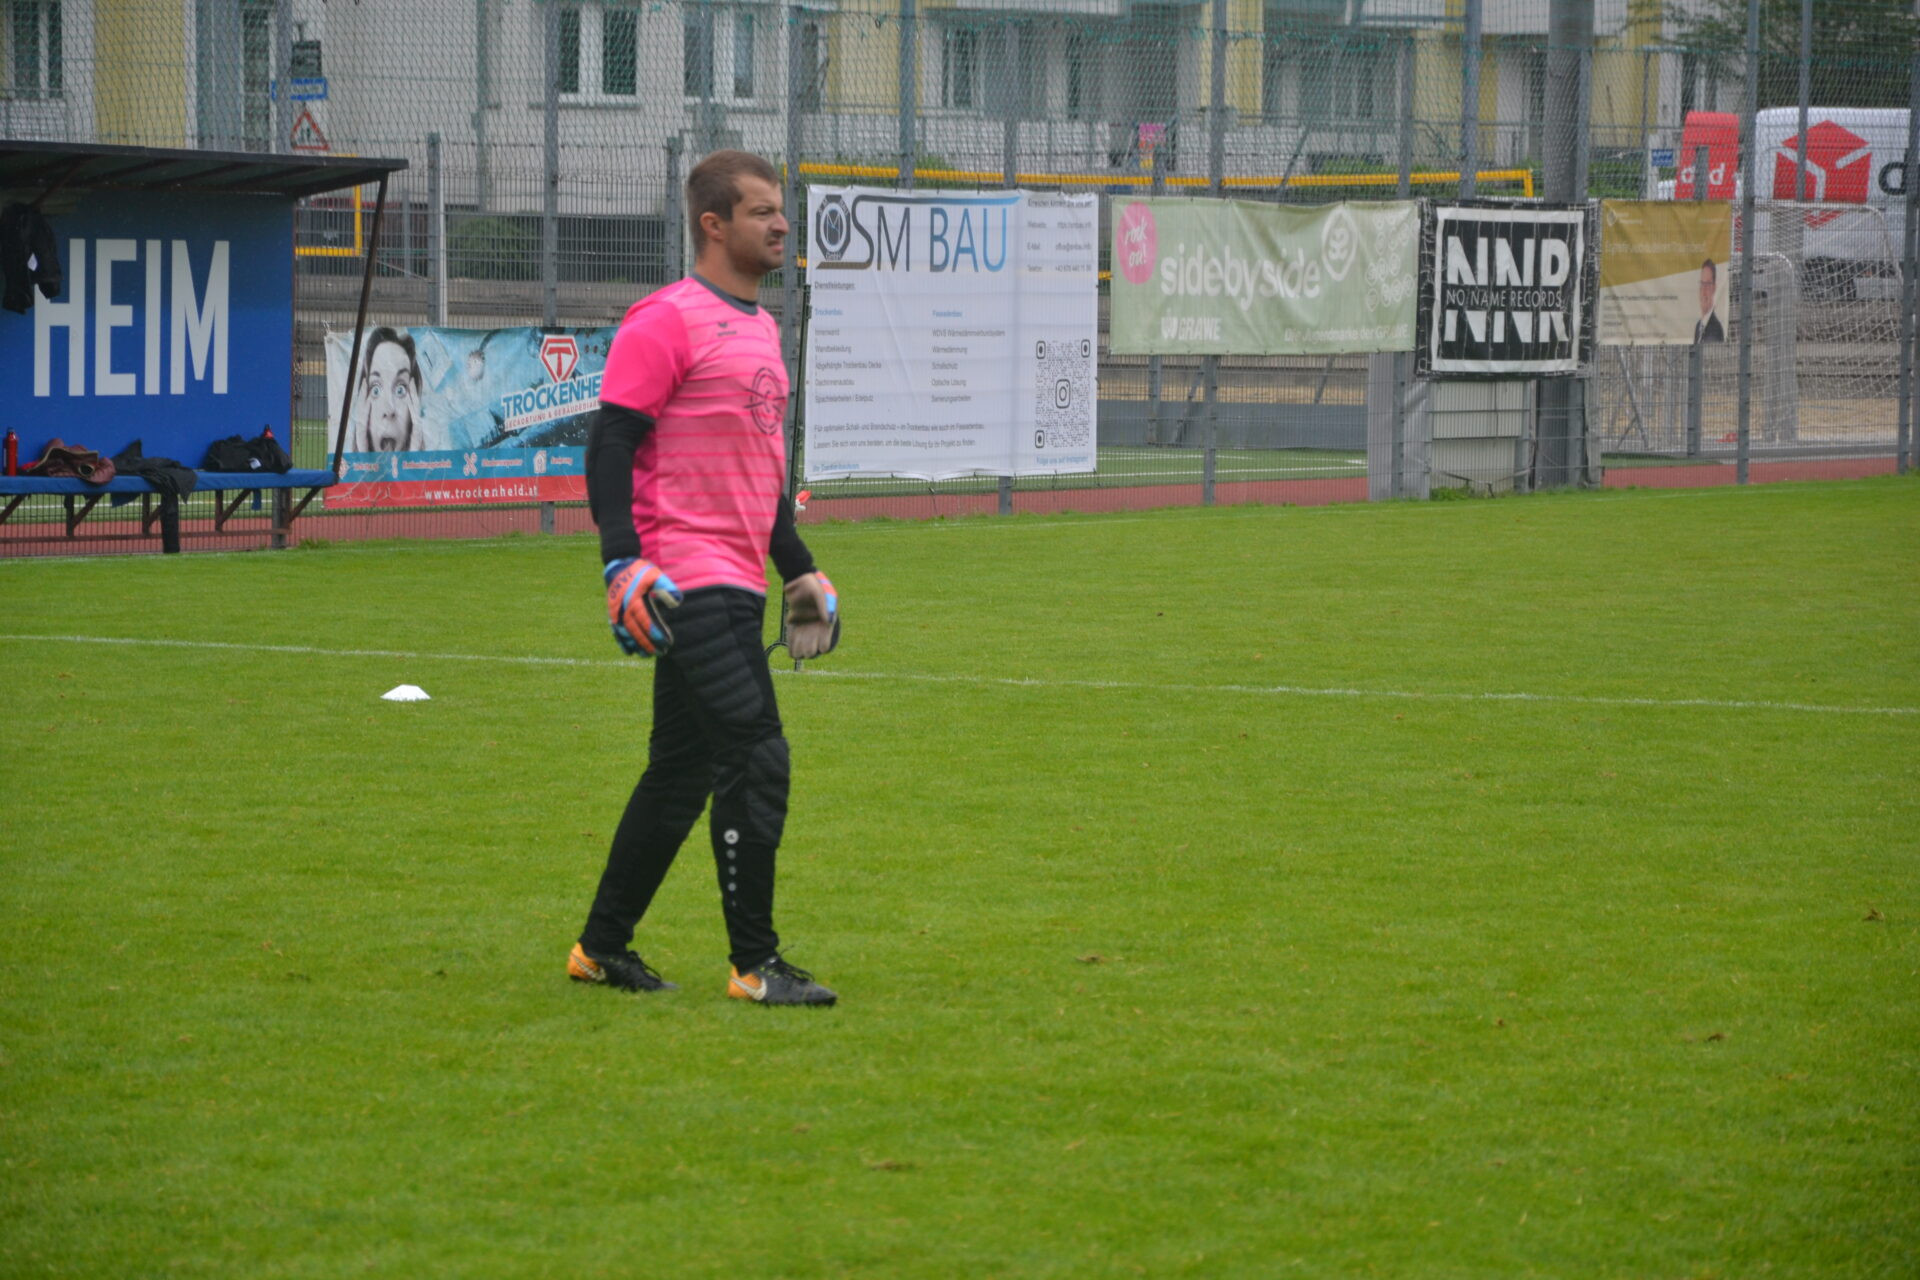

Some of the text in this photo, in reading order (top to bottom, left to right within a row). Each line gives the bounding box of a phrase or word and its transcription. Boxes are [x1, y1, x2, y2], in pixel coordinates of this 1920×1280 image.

[1681, 164, 1725, 185] dd
[930, 207, 1009, 273] BAU
[1160, 243, 1321, 311] sidebyside
[1446, 289, 1562, 308] NO NAME RECORDS
[34, 238, 229, 397] HEIM
[1178, 316, 1222, 342] GRAWE
[503, 373, 603, 418] TROCKENHE
[425, 484, 539, 500] www.trockenheld.at
